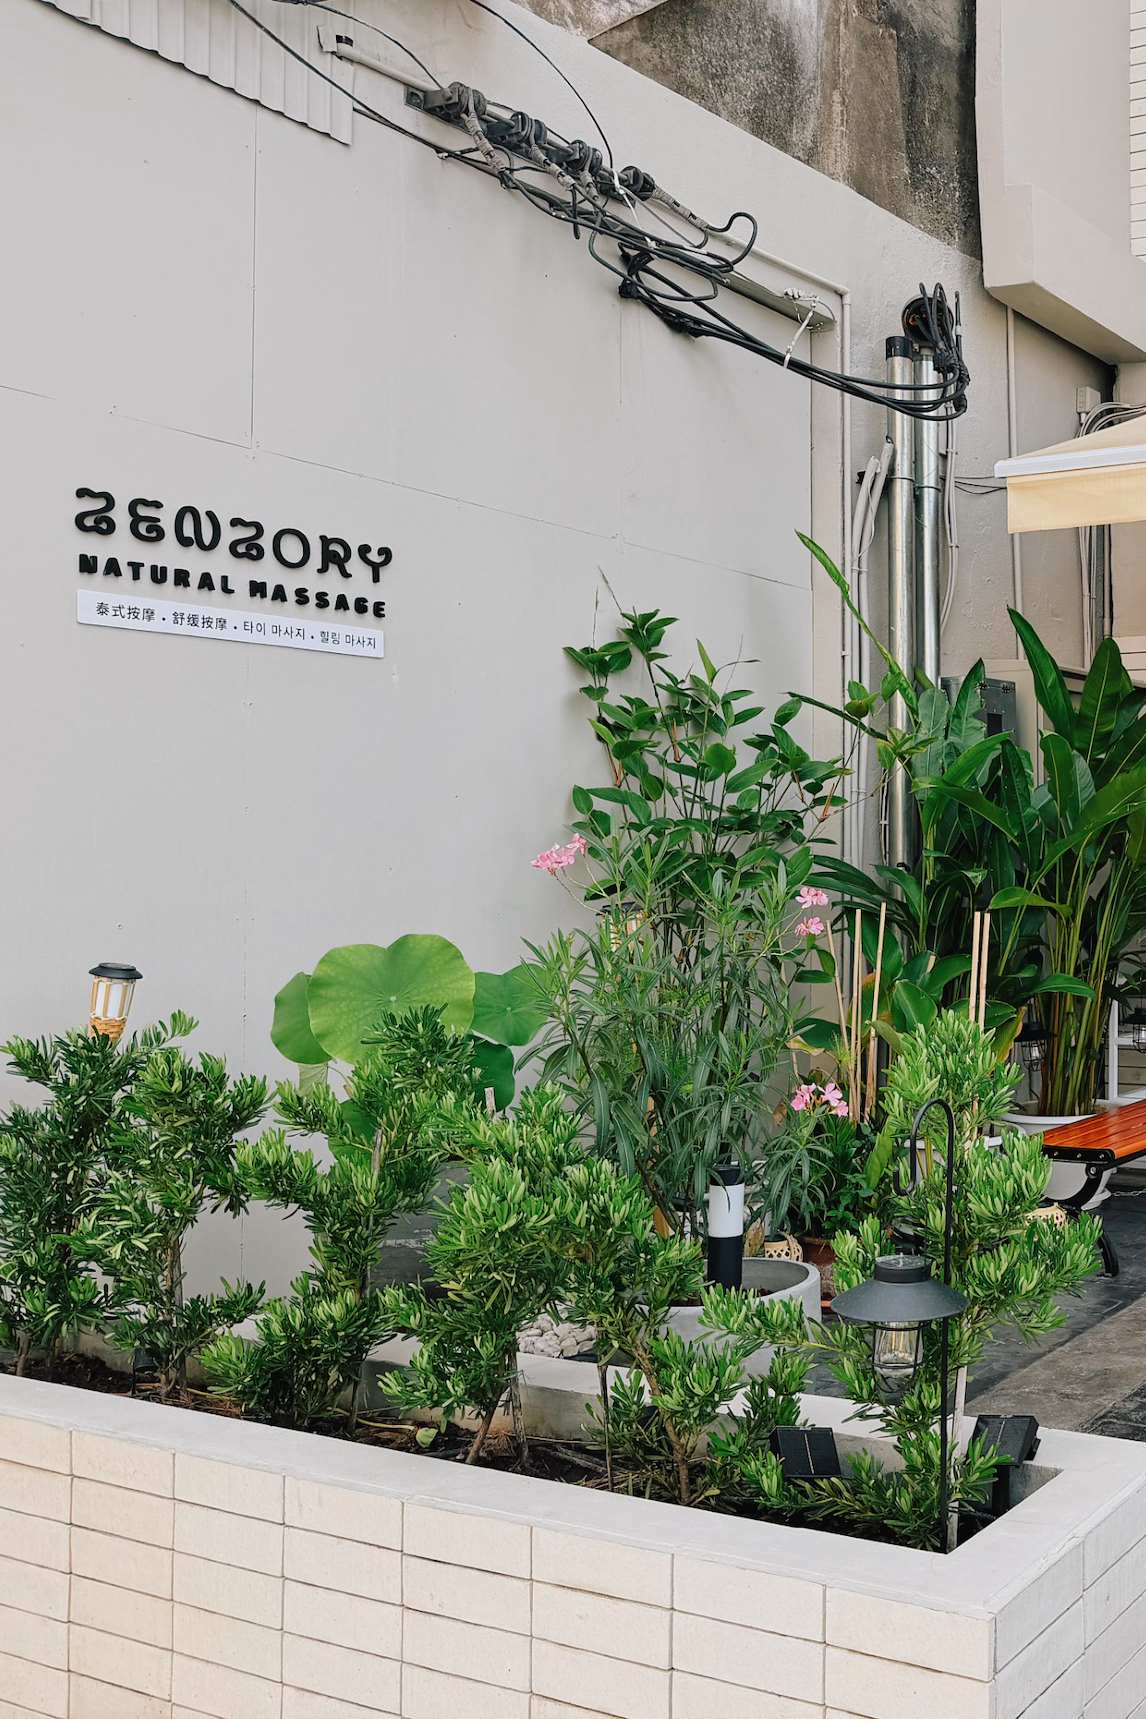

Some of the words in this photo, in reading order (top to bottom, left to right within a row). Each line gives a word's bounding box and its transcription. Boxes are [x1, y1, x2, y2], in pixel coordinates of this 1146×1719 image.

[74, 487, 393, 583] ZENZORY
[79, 554, 235, 594] NATURAL
[249, 580, 386, 618] MASSAGE
[95, 602, 156, 622] 泰式按摩
[172, 611, 228, 631] 舒缓按摩
[243, 622, 267, 637] 타이
[271, 625, 305, 640] 마사지
[345, 633, 377, 650] 마사지
